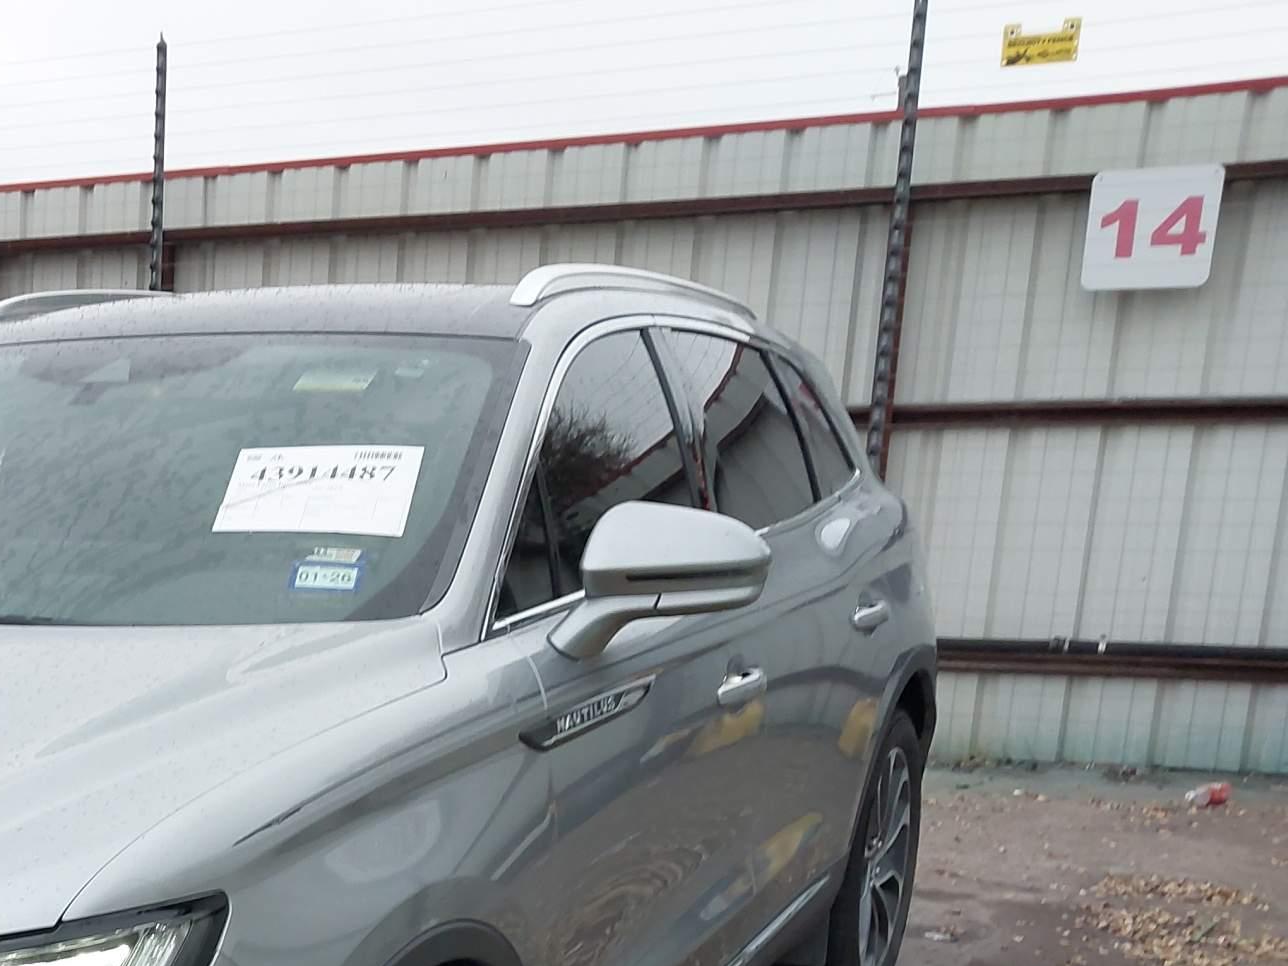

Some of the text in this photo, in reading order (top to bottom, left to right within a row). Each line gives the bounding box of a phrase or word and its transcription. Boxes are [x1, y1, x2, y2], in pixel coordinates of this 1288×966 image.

[1100, 194, 1207, 259] 14
[250, 463, 397, 482] 43914487
[556, 695, 616, 734] NAUTILUS
